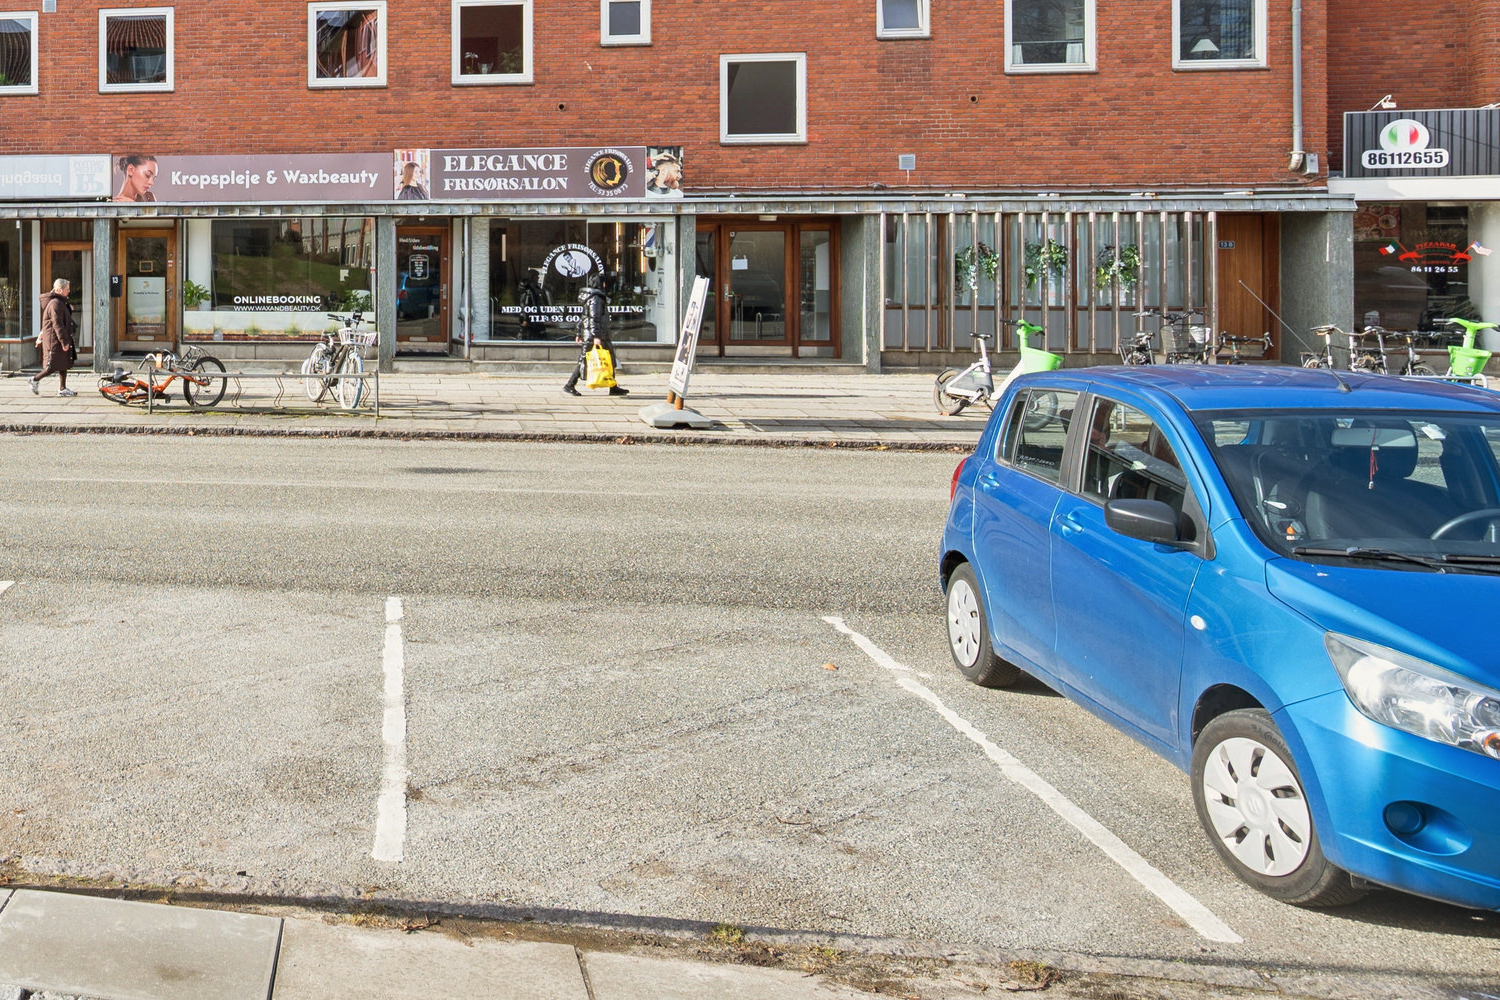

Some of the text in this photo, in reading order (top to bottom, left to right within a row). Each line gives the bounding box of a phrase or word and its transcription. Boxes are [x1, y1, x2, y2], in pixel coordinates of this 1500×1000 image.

[443, 154, 568, 172] ELEGANCE
[1367, 151, 1444, 166] 86112655
[171, 169, 379, 189] Kropspleje & Waxbeauty
[443, 177, 569, 191] FRISØRSALON
[111, 276, 119, 284] 13
[233, 295, 321, 304] ONLINEBOOKING
[501, 305, 522, 313] MED
[523, 305, 538, 313] OG
[540, 305, 565, 313] UDEN
